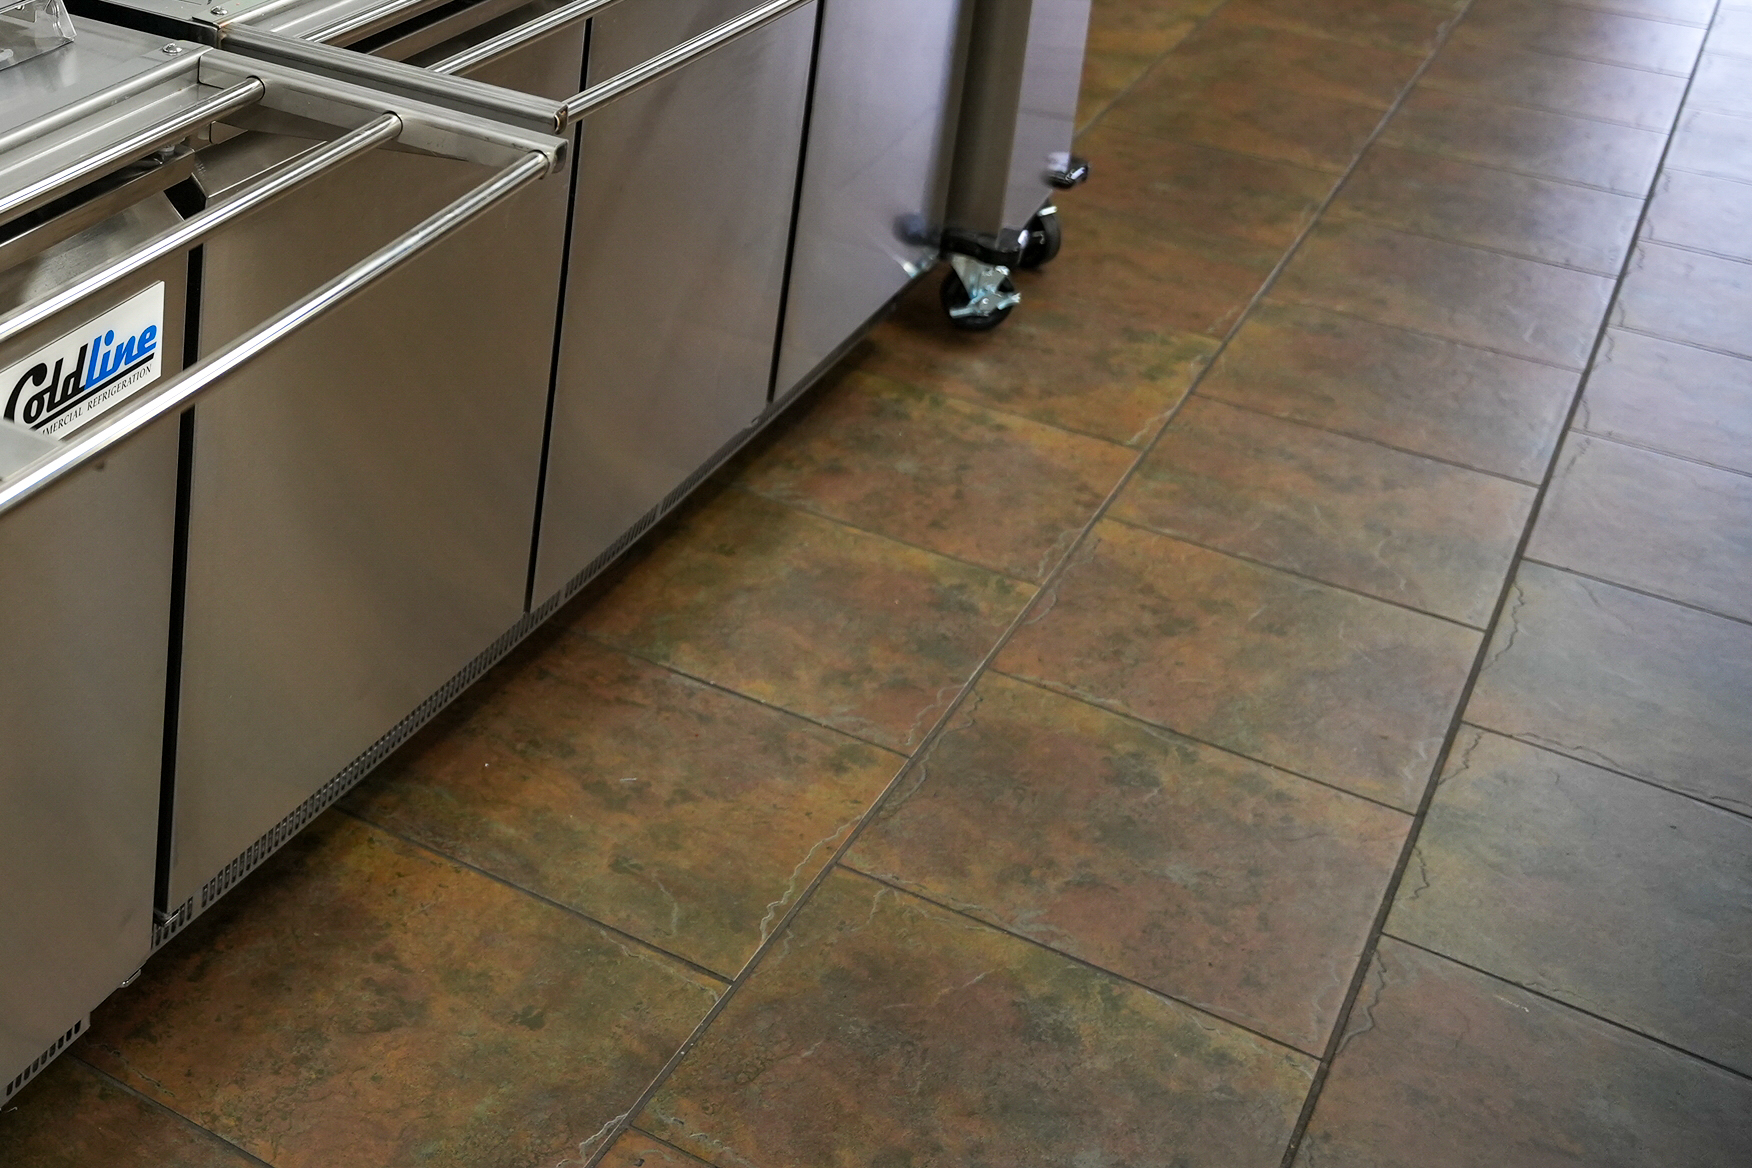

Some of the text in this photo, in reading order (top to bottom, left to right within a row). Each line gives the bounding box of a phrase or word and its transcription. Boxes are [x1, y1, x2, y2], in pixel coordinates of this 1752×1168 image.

[3, 323, 157, 424] Coldline
[43, 363, 152, 435] MERCIAL REFRIGERATION
